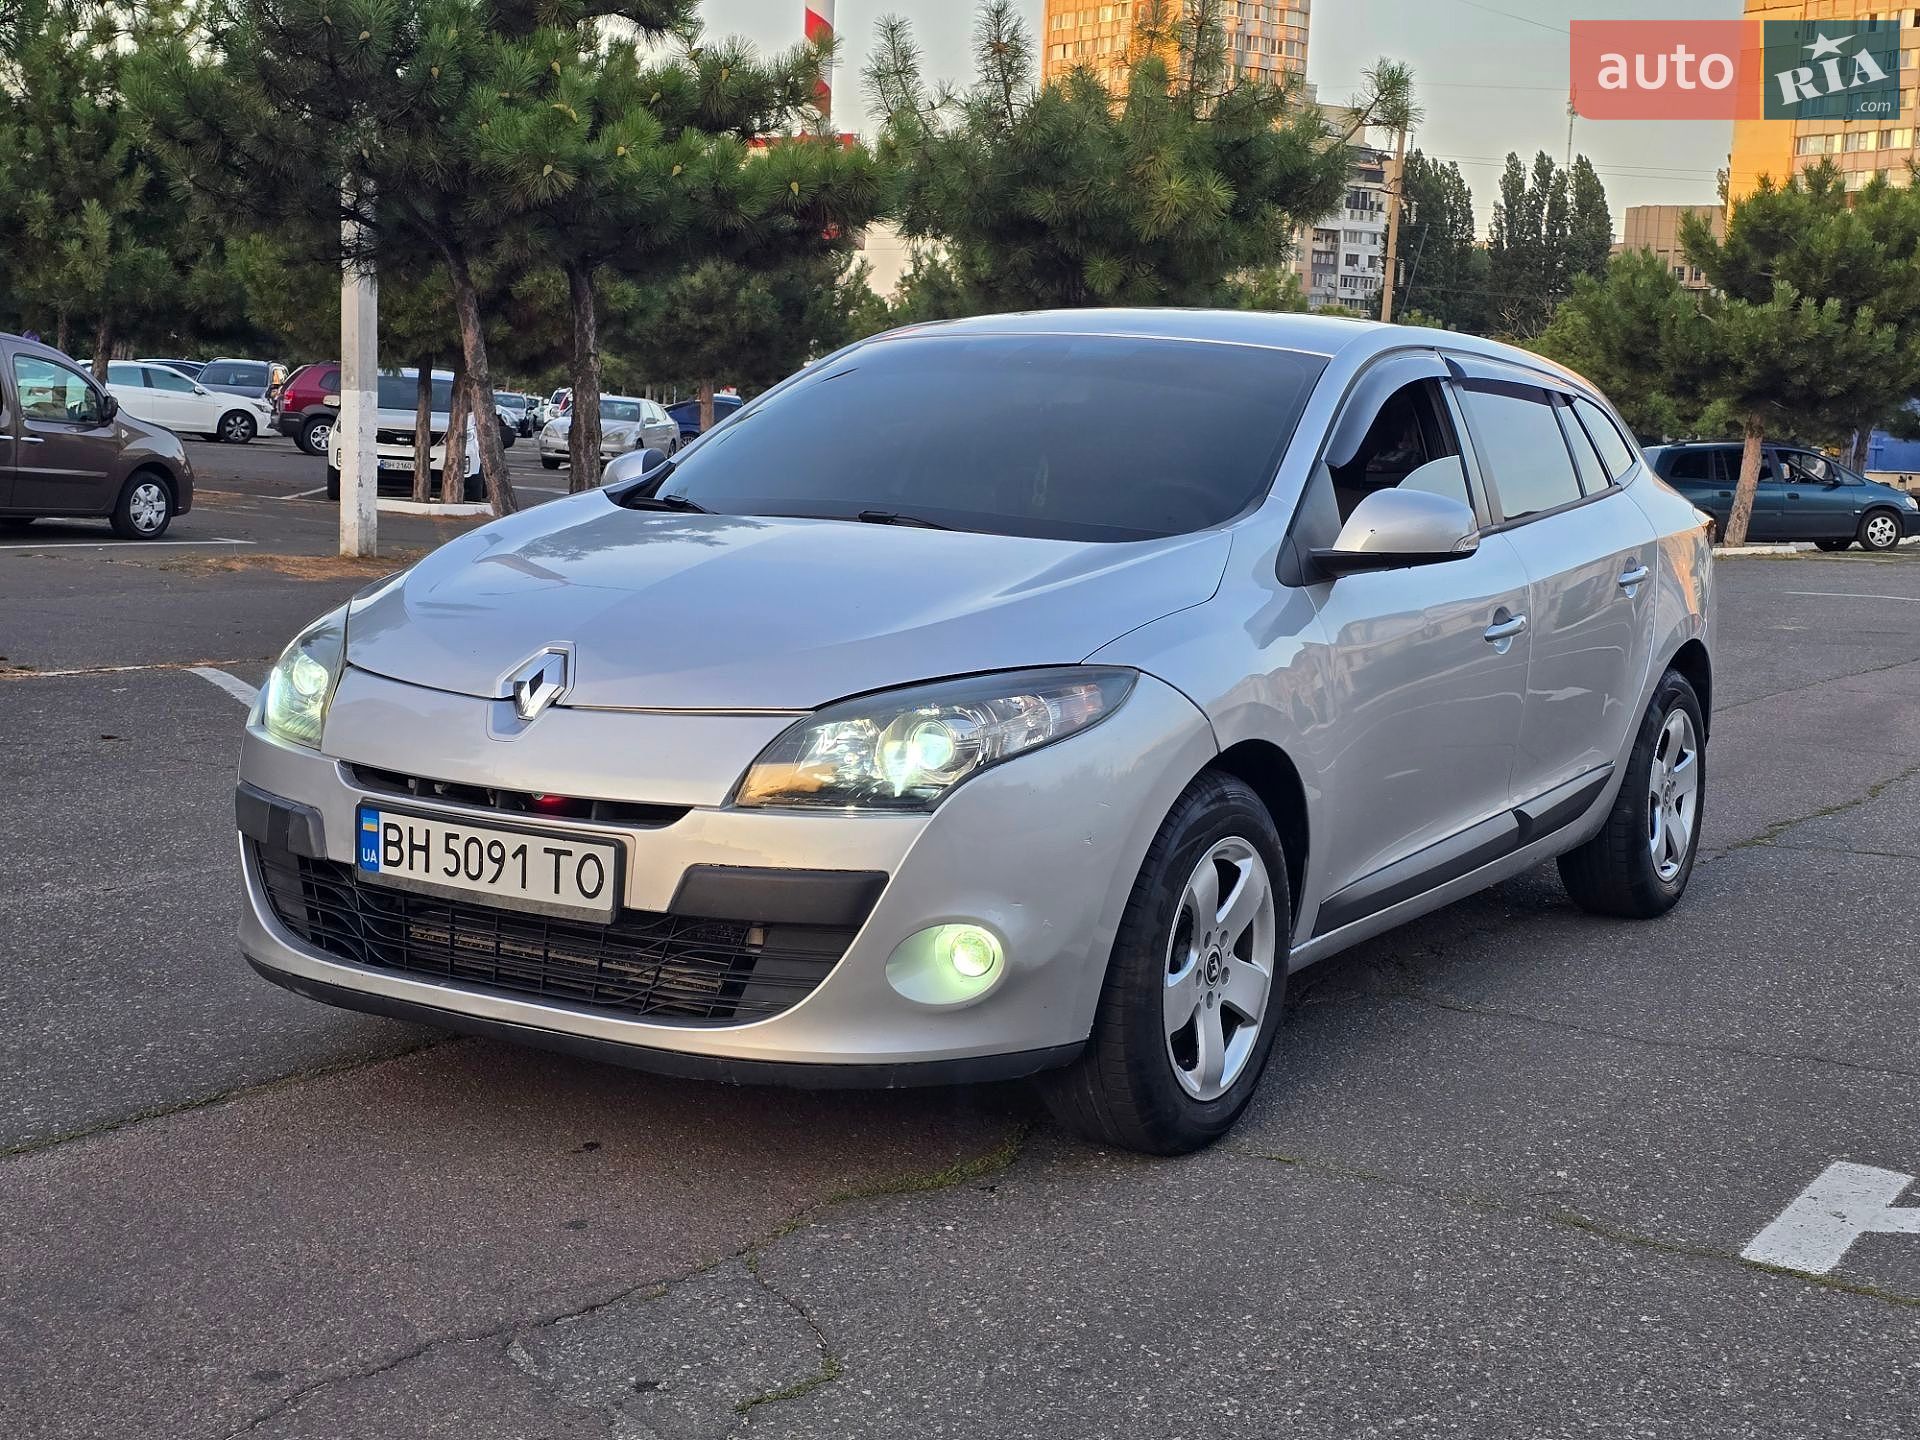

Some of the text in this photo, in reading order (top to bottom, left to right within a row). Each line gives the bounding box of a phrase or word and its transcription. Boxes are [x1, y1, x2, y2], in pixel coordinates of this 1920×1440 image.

[362, 848, 378, 864] UA
[383, 822, 605, 900] BH 5091 TO
